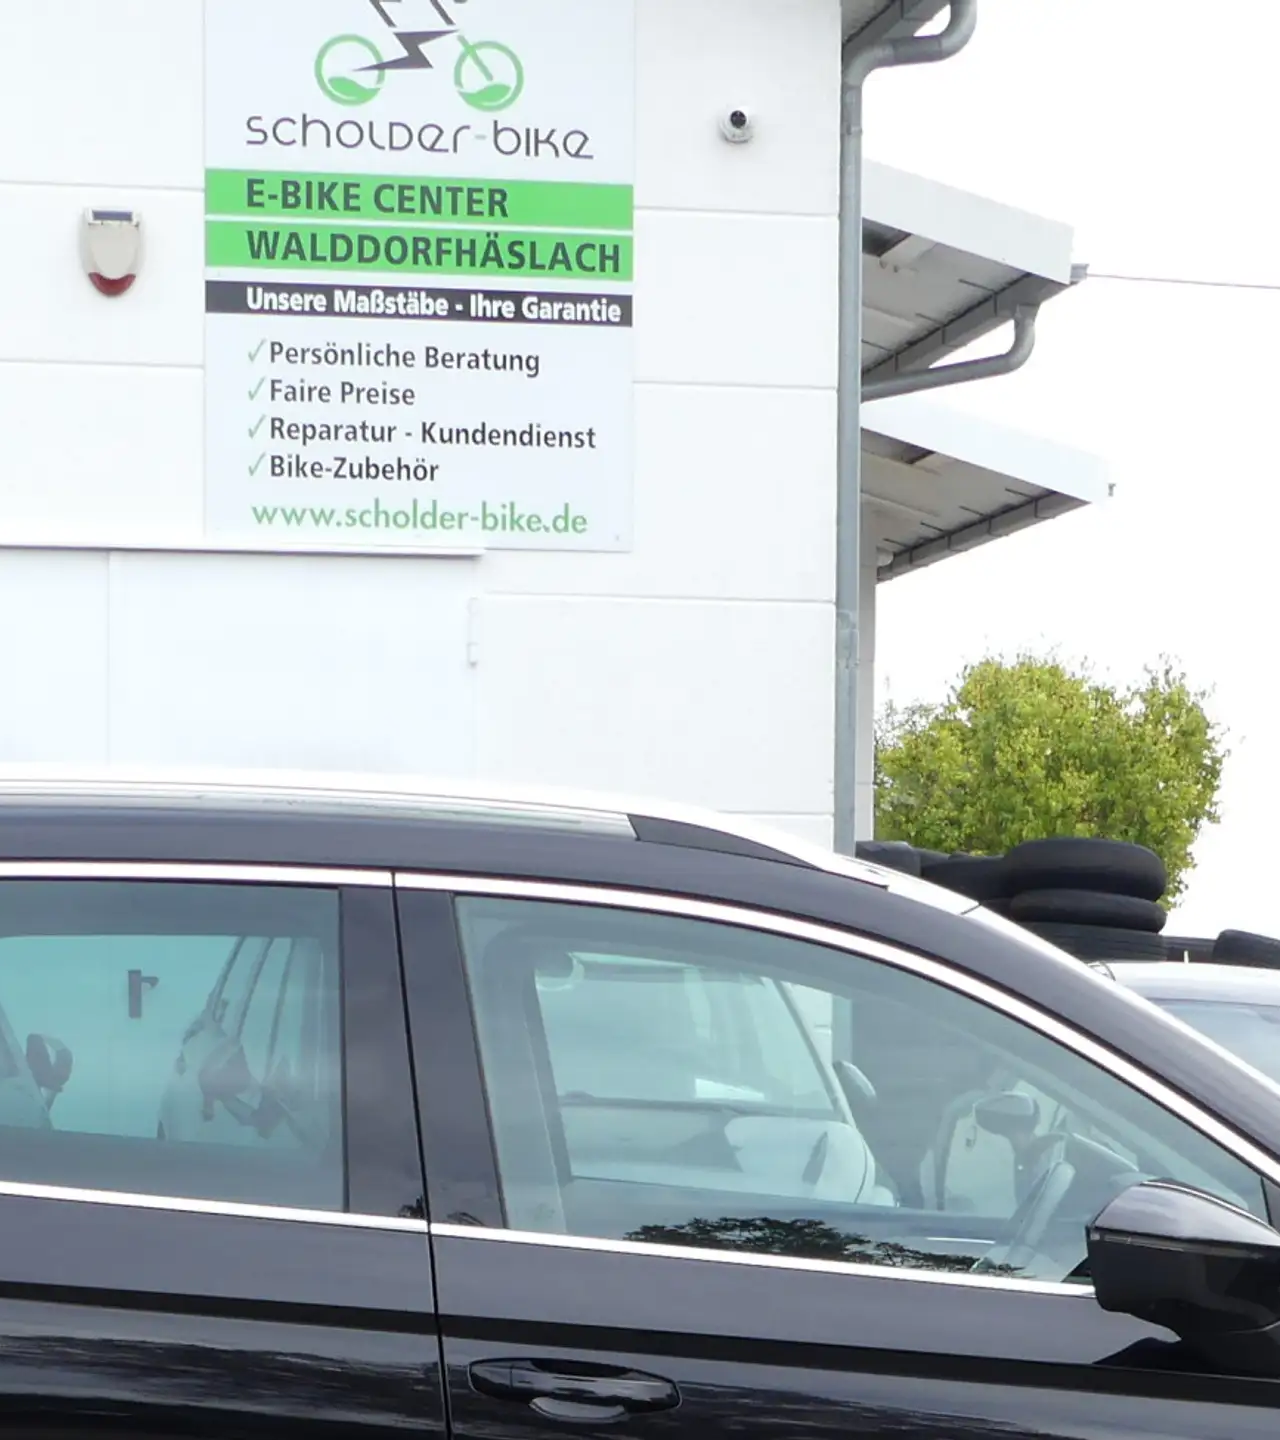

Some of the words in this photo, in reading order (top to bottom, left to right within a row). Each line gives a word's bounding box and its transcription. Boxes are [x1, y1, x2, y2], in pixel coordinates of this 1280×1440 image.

[246, 178, 362, 212] E-BIKE
[373, 183, 509, 218] CENTER
[246, 229, 620, 273] WALDDORFHÄSLACH
[246, 286, 327, 312] Unsere
[333, 289, 449, 317] Maßstäbe
[470, 293, 515, 318] Ihre
[521, 296, 621, 323] Garantie
[270, 341, 416, 369] Persönliche
[424, 346, 540, 378] Beratung
[270, 379, 332, 403] Faire
[340, 382, 416, 406] Preise
[270, 417, 397, 446] Reparatur
[421, 421, 596, 449] Kundendienst
[270, 455, 440, 482] Bike-Zubehör
[251, 497, 588, 534] www.scholder-bike.de
